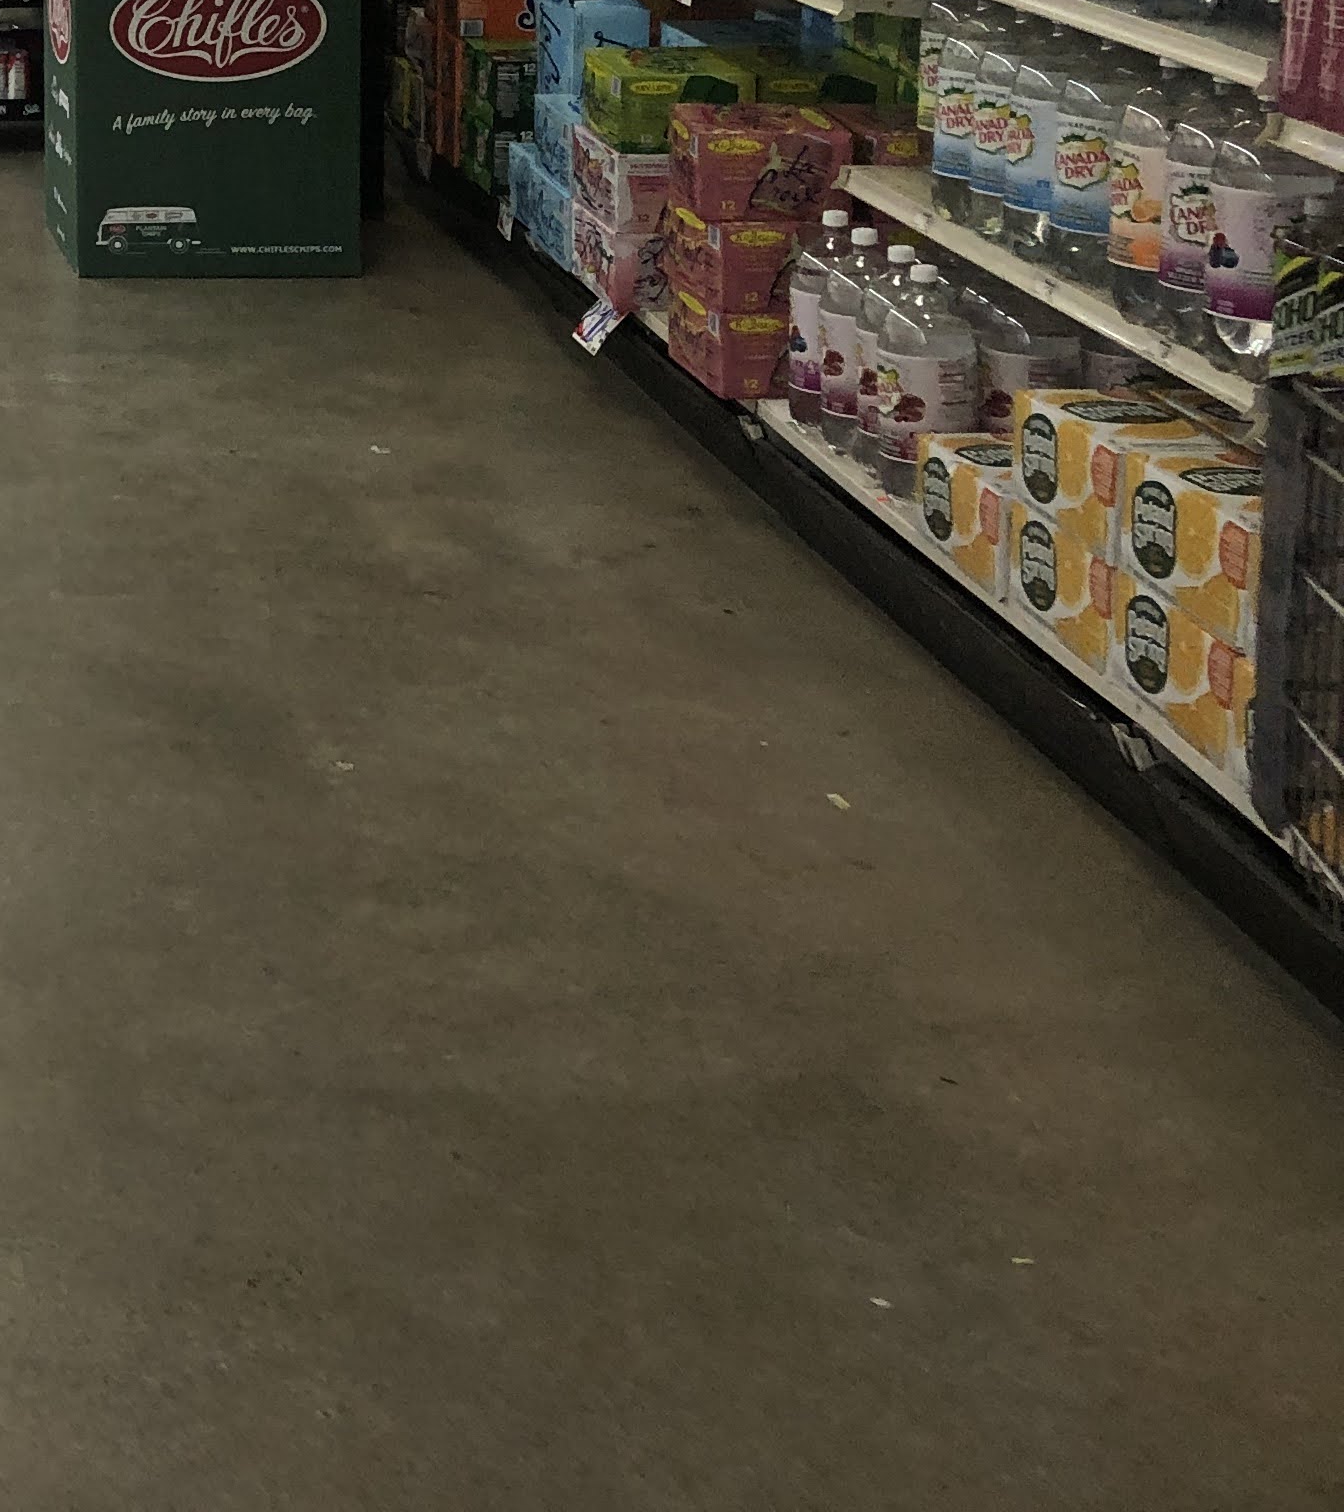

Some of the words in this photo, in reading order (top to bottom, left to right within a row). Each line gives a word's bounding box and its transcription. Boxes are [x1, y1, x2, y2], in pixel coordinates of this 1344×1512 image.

[112, 115, 122, 131] A
[126, 108, 176, 135] family
[179, 104, 217, 128] story
[221, 104, 238, 121] in
[241, 104, 282, 125] every
[1064, 164, 1095, 179] DRY
